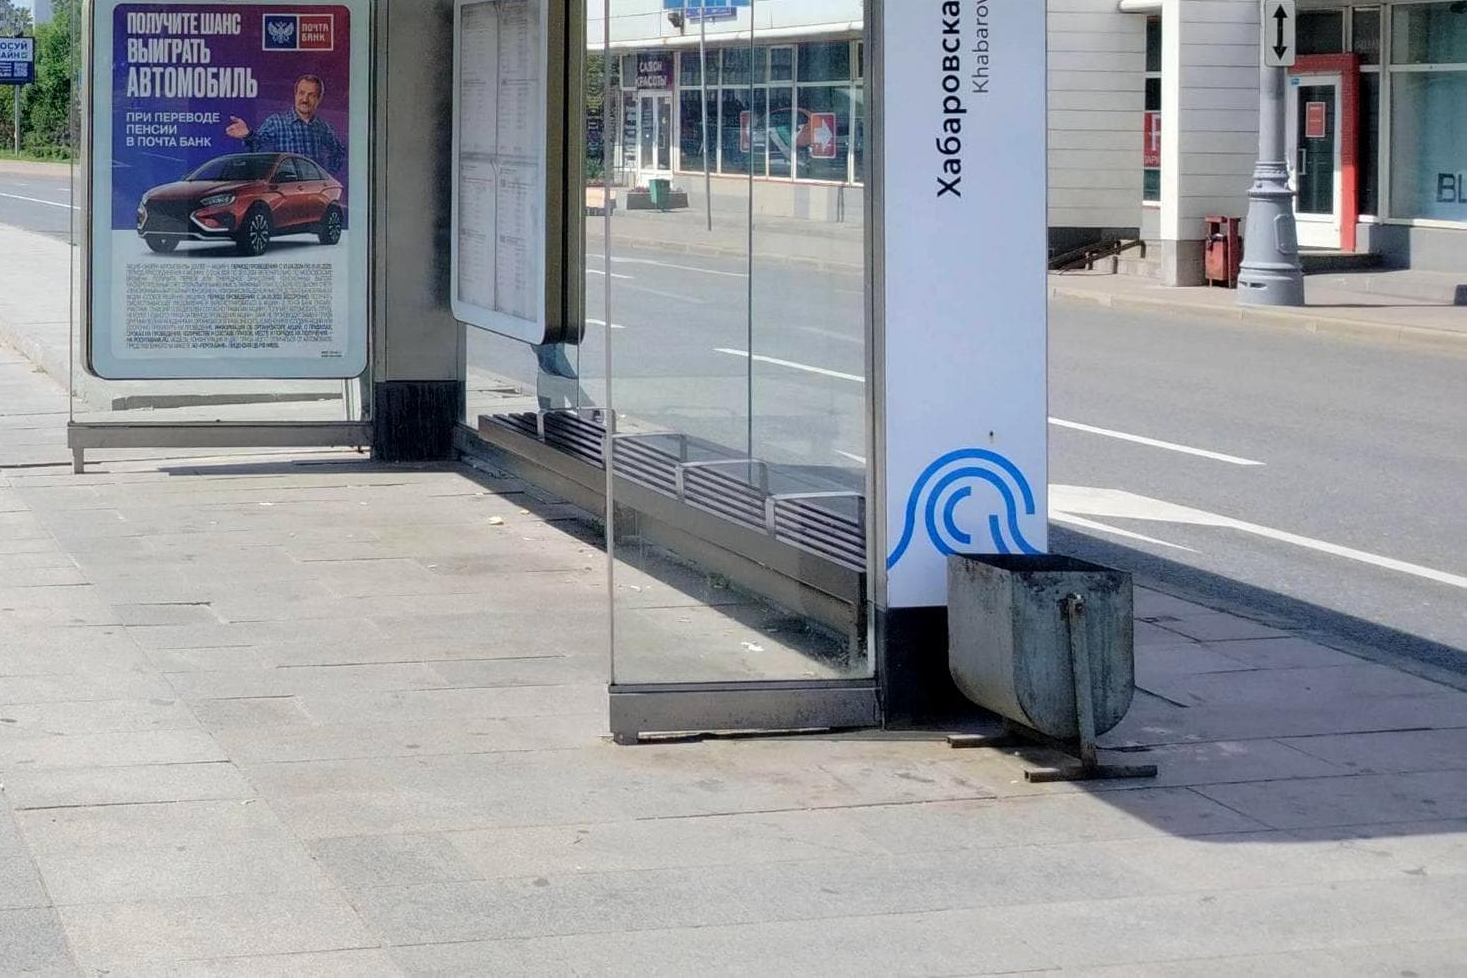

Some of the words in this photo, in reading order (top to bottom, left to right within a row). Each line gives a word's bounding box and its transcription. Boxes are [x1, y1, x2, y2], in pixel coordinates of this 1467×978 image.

[127, 12, 198, 35] ПОЛУЧИТЕ
[200, 12, 242, 35] ШАНС
[300, 22, 330, 32] ПОЧТА
[300, 32, 326, 42] БАНК
[128, 38, 211, 64] ВЫИГРАТЬ
[127, 67, 258, 99] АВТОМОБИЛЬ
[126, 112, 151, 123] ПРИ
[154, 112, 220, 125] ПЕРЕВОДЕ
[126, 124, 178, 135] ПЕНСИИ
[126, 136, 135, 147] В
[137, 136, 178, 147] ПОЧТА
[179, 136, 212, 147] БАНК
